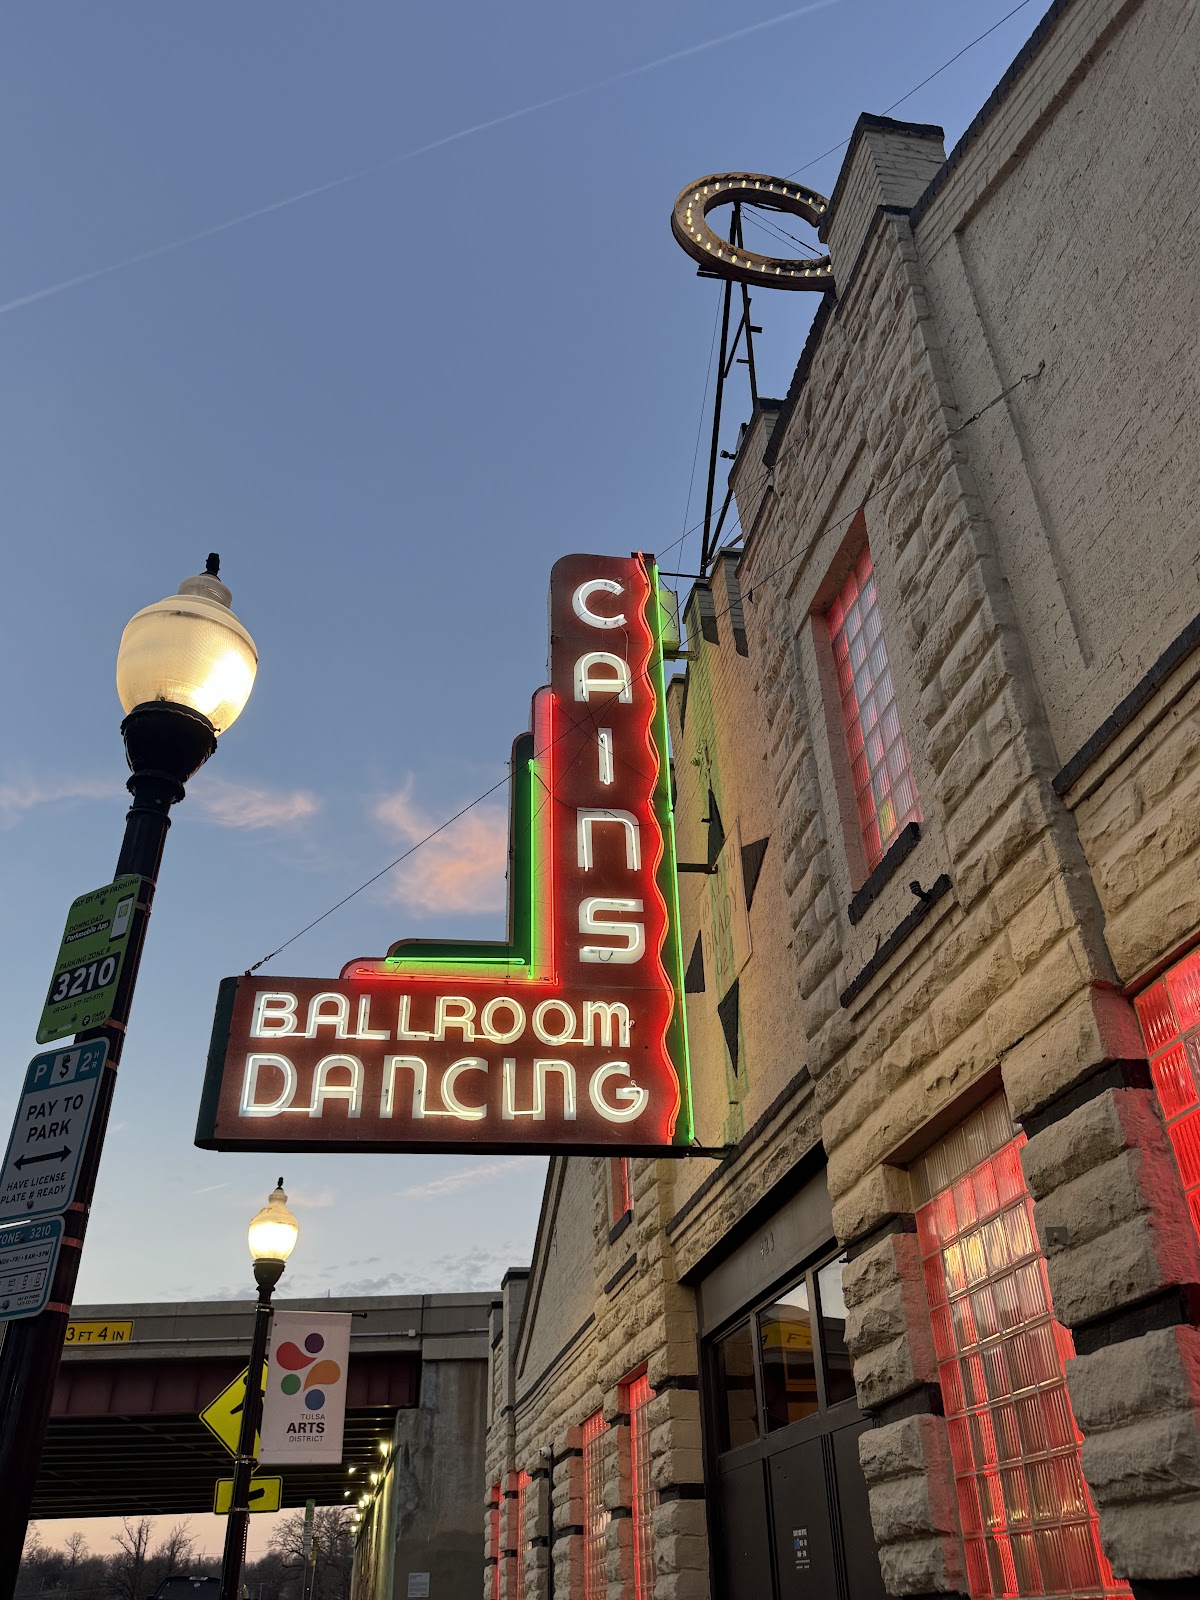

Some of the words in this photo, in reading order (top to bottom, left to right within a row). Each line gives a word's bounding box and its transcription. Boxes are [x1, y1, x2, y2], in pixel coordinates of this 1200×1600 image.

[571, 577, 646, 965] CAINS
[71, 898, 85, 908] PAY
[86, 896, 95, 904] BY
[96, 888, 109, 900] APP
[110, 876, 140, 894] PARKING
[69, 914, 104, 932] DOWNLOAD
[97, 921, 109, 932] App
[704, 876, 738, 965] BRADY
[59, 955, 88, 970] PARKING
[88, 949, 105, 960] ZONE
[52, 956, 116, 1002] 3210
[60, 1003, 72, 1011] CALL
[249, 990, 632, 1047] BALLROOM
[34, 1063, 48, 1084] P
[239, 1053, 650, 1124] DANCING
[26, 1099, 59, 1121] PAY
[64, 1093, 84, 1113] TO
[26, 1118, 72, 1143] PARK
[6, 1179, 30, 1192] HAVE
[30, 1171, 67, 1187] LICENSE
[0, 1192, 28, 1204] PLATE
[28, 1191, 35, 1200] #
[36, 1183, 67, 1198] READY
[29, 1224, 51, 1239] 3210
[78, 1331, 94, 1341] FT
[97, 1326, 108, 1341] 4
[112, 1331, 125, 1341] IN
[286, 1422, 325, 1434] ARTS
[288, 1435, 324, 1443] DISTRICT
